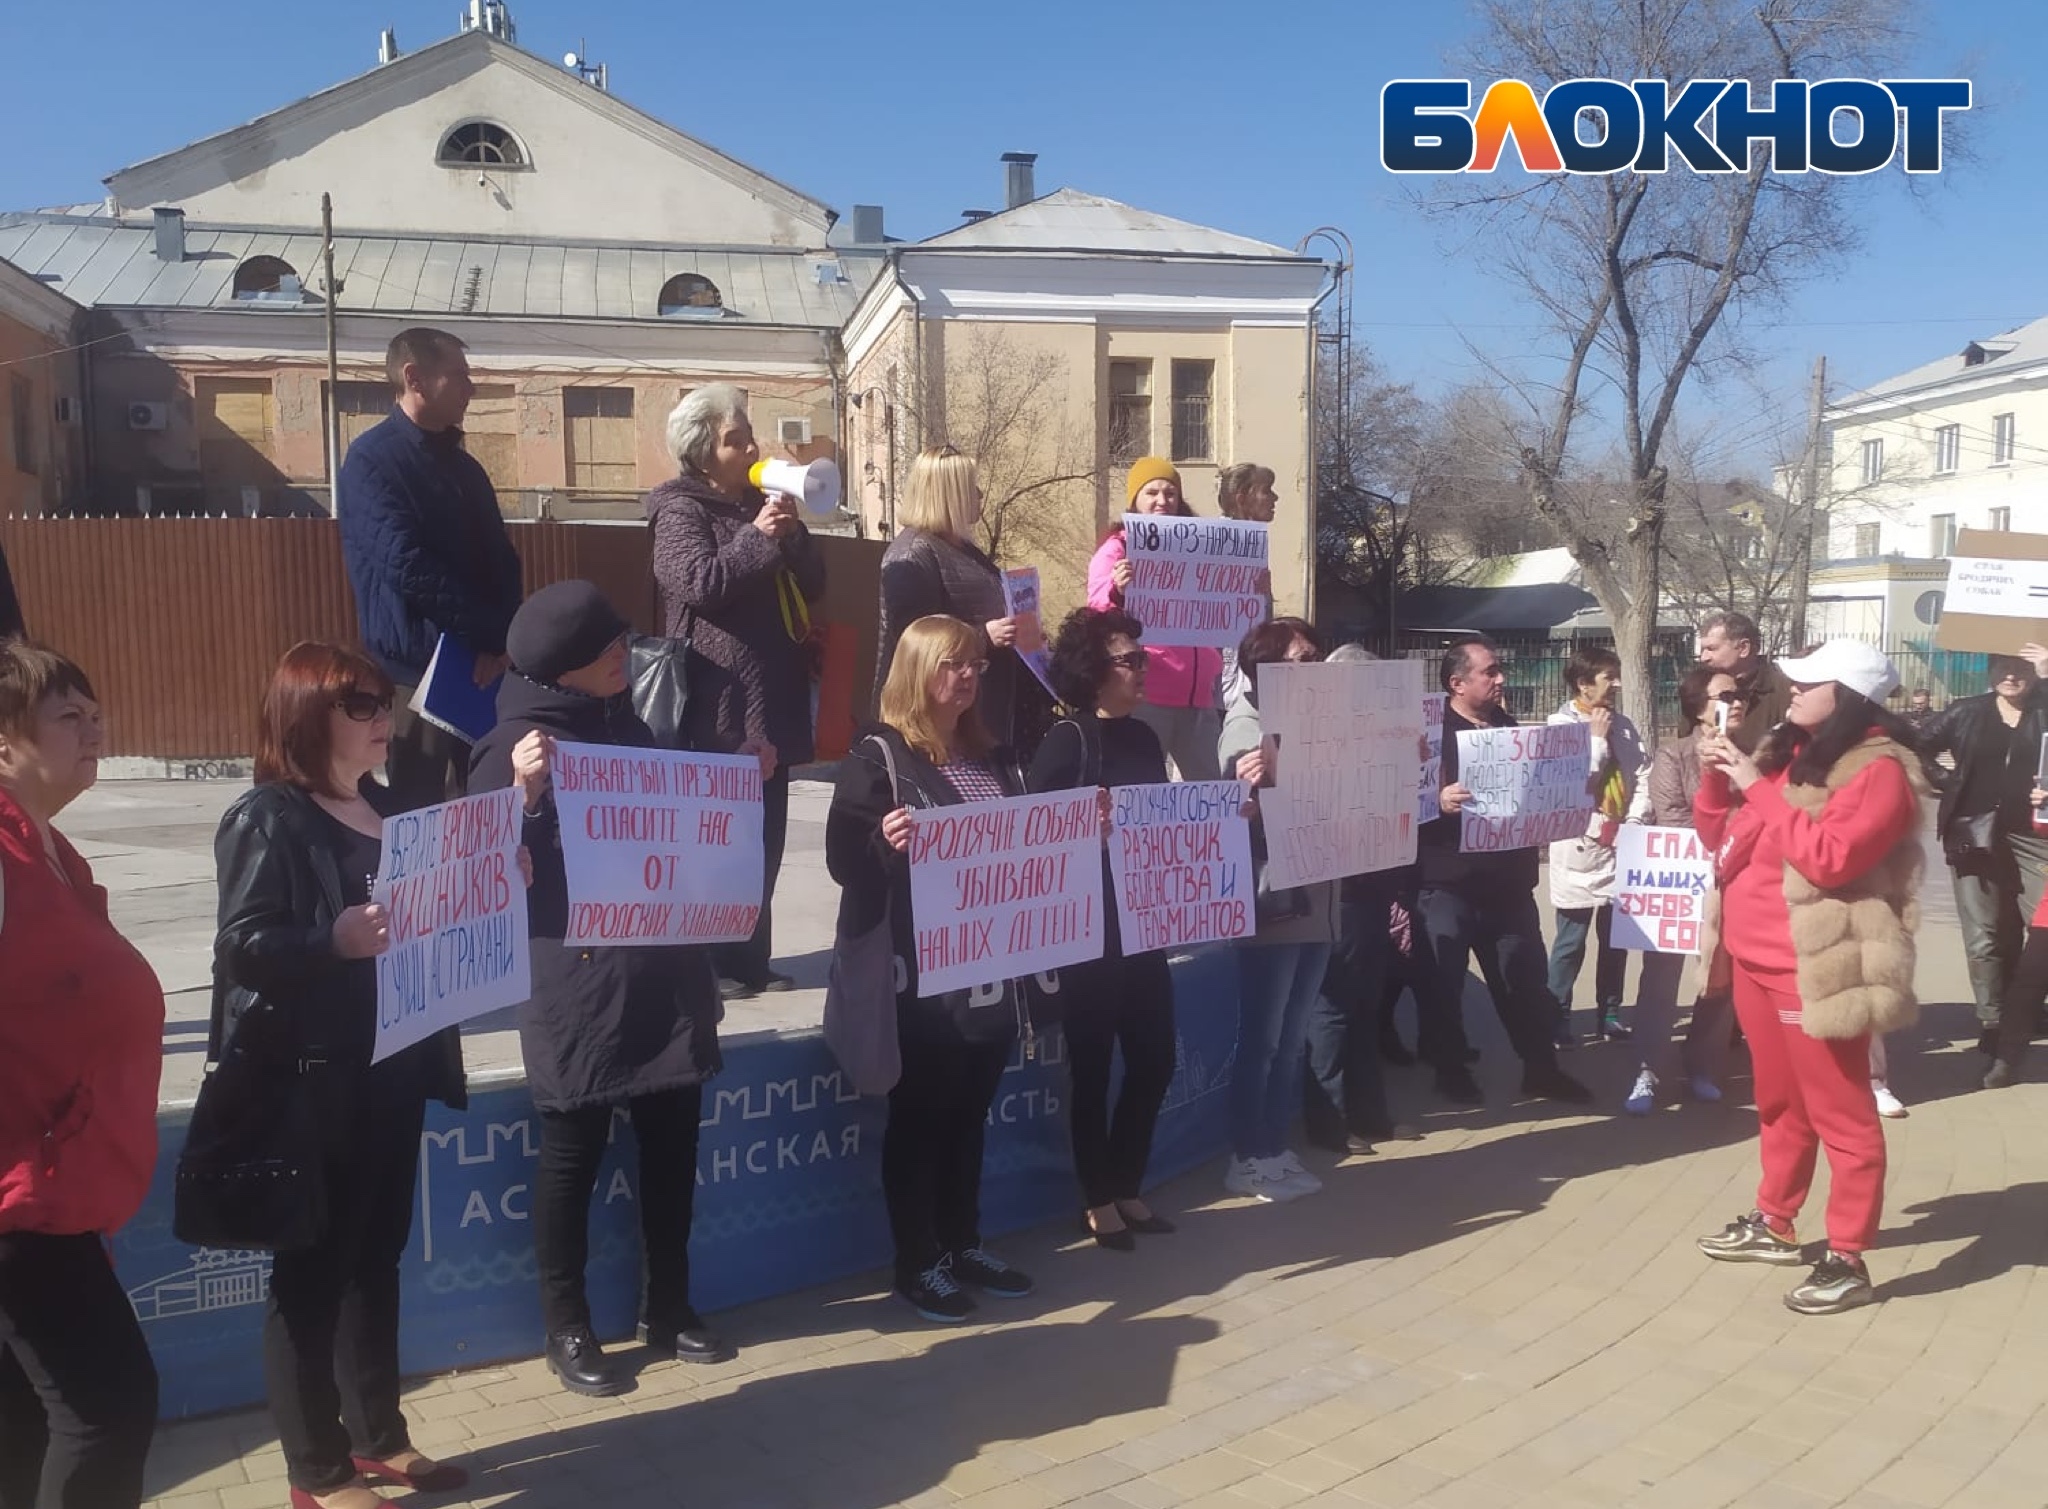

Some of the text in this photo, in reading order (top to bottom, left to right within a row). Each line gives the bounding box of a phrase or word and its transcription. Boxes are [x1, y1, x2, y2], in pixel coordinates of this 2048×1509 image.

[1133, 558, 1260, 594] ПРАВА ЧЕЛОВЕК
[1138, 595, 1231, 629] КОНСТИТУЦИЮ
[1235, 597, 1260, 630] РФ
[1510, 729, 1523, 762] 3
[553, 753, 667, 796] УВАЖАЕМЫЙ
[1520, 762, 1530, 788] В
[1116, 784, 1241, 826] БРОДЯЧАЯ СОБАКА
[1475, 788, 1519, 815] БРАТЬ
[441, 791, 516, 865] БРОДЯЧИХ
[586, 805, 734, 846] СПАСИТЕ НАС
[911, 797, 1098, 865] БРОДЯЧИЕ СОБАКИ
[1122, 821, 1223, 871] РАЗНОСЧИК
[643, 855, 680, 891] ОТ
[955, 852, 1073, 911] УБИВАЮТ
[1125, 862, 1236, 912] БЕШЕНСТВА И
[1627, 869, 1706, 891] НАШИХ
[567, 902, 673, 939] ГОРОДСКИХ
[1137, 900, 1246, 949] ГЕЛЬМИНТОВ
[1619, 892, 1694, 918] ЗУБОВ
[919, 917, 994, 973] НАШИХ
[1658, 918, 1698, 949] СО
[431, 912, 515, 999] АСТРАХАНИ
